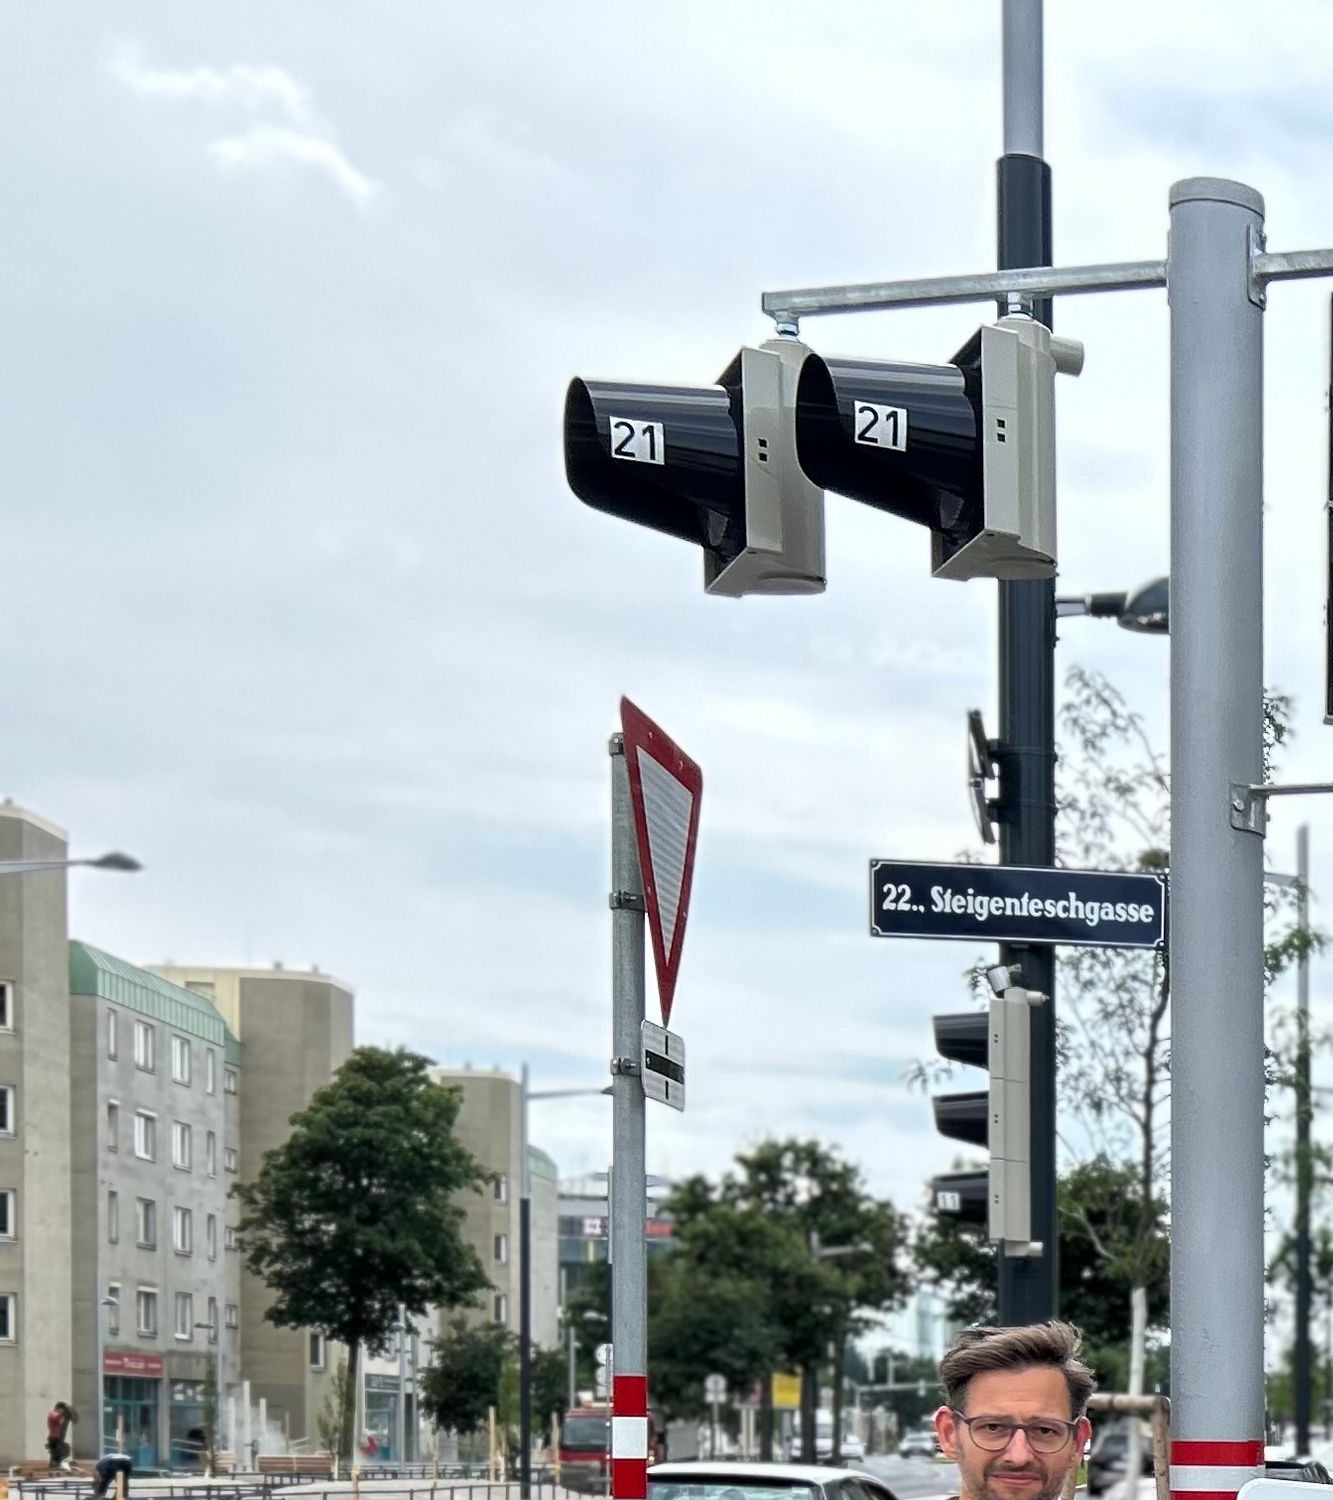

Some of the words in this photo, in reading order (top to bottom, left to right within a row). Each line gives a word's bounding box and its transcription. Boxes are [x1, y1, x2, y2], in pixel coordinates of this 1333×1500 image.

[613, 420, 657, 461] 21
[857, 405, 899, 447] 21
[881, 883, 925, 913] 22.,
[930, 885, 1155, 927] Steigenteschgasse
